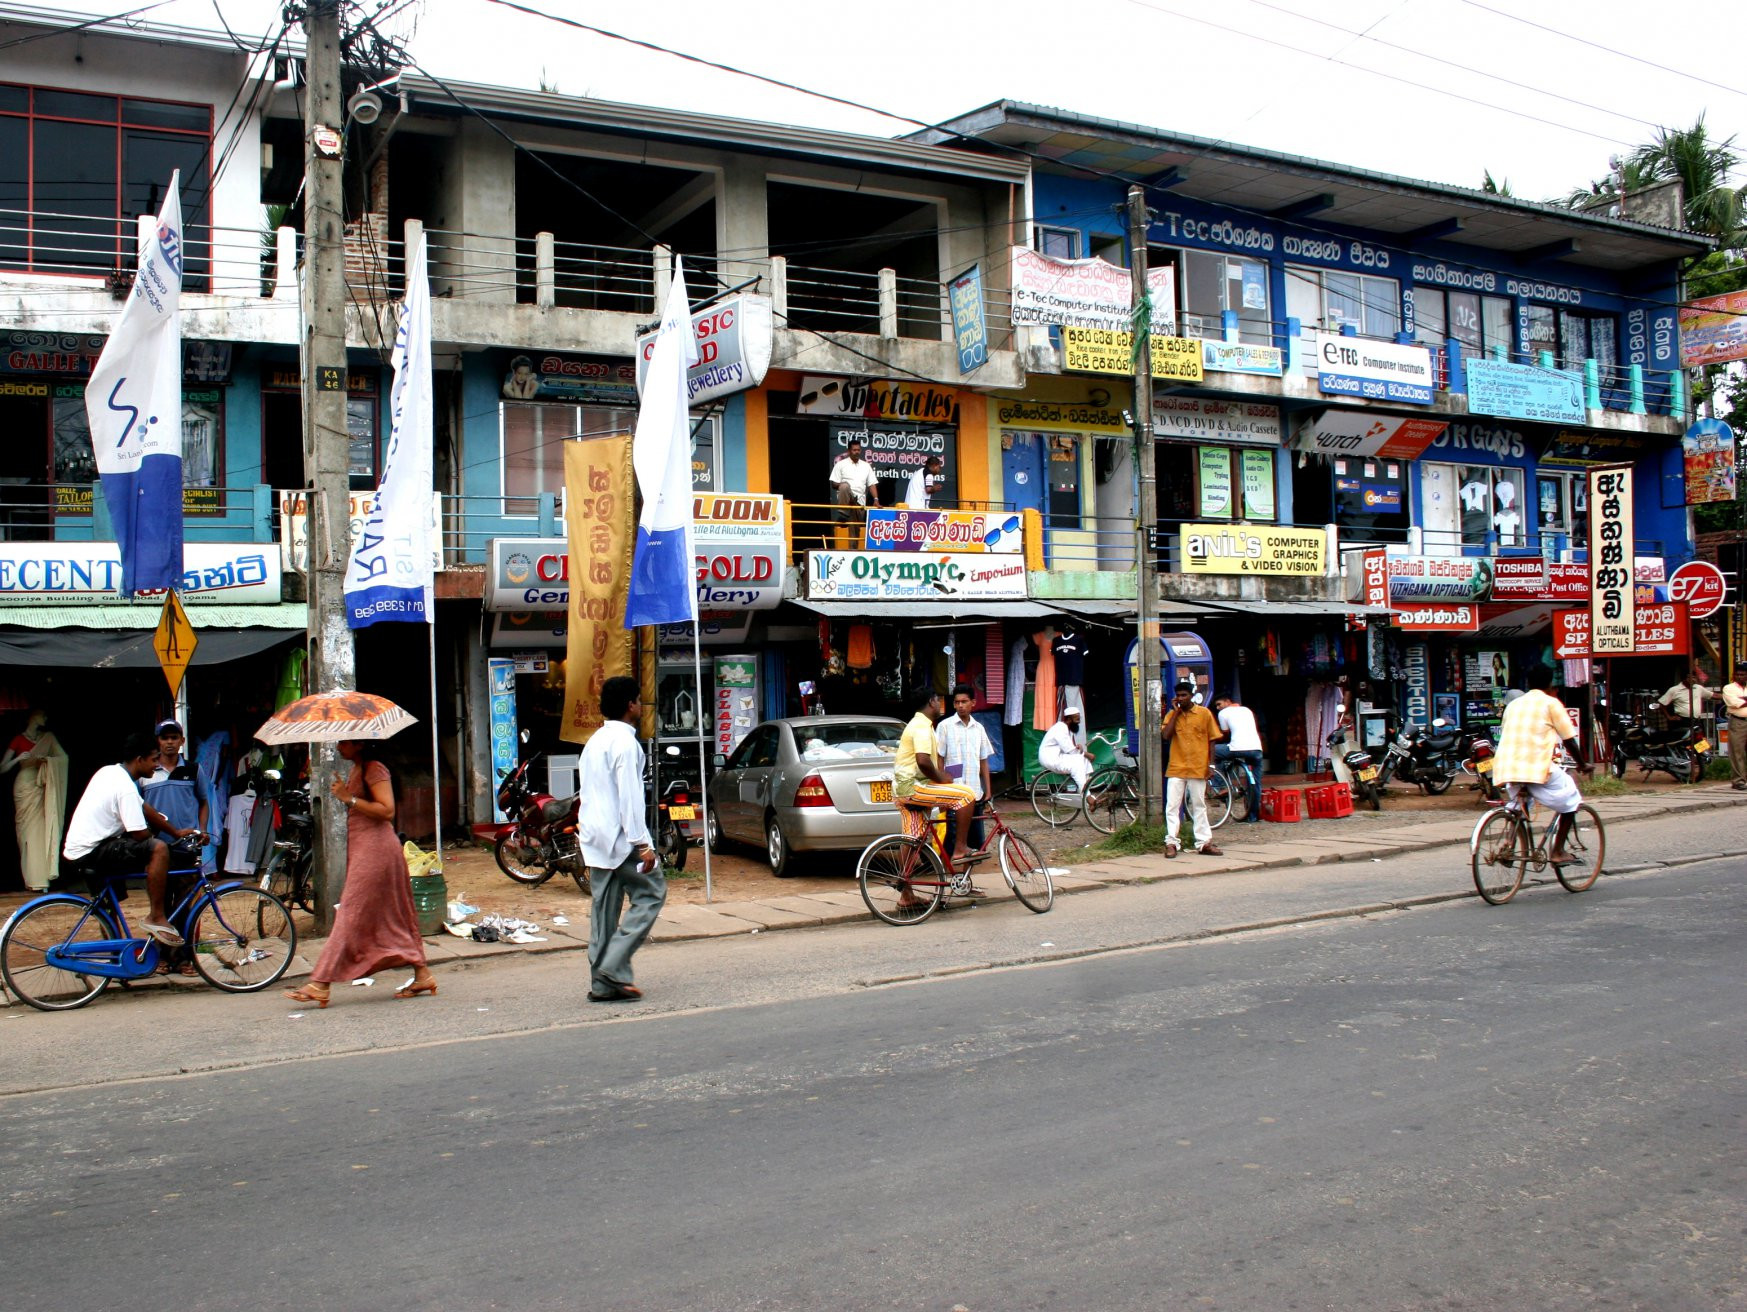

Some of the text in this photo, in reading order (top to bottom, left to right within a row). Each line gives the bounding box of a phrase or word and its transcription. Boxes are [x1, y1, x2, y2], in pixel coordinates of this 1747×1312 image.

[1048, 296, 1093, 311] Computer
[1094, 302, 1132, 316] Institute
[9, 351, 80, 371] GALLE
[1363, 356, 1397, 371] Computer
[324, 370, 338, 379] KA
[839, 380, 954, 417] Spectacles
[1217, 419, 1225, 430] &
[872, 431, 945, 452] කණ්ණාඩි
[873, 467, 899, 479] ineth
[868, 514, 986, 545] ඇස් කණ්ණාඩි
[1267, 537, 1319, 549] COMPUTER
[1273, 550, 1318, 560] GRAPHICS
[695, 555, 773, 581] GOLD
[851, 556, 960, 586] Olympic
[970, 564, 1023, 584] Emporium
[1241, 561, 1318, 572] & VIDEO VISION
[1496, 563, 1543, 573] TOSHIBA
[1389, 583, 1473, 597] UTHGAMA OPTICALS
[1551, 583, 1567, 592] Post
[1704, 579, 1719, 590] kit
[697, 586, 760, 606] llery
[1596, 625, 1630, 636] ALUTHGAMA
[1598, 638, 1630, 649] OPTICALS
[718, 689, 732, 753] CLASSI
